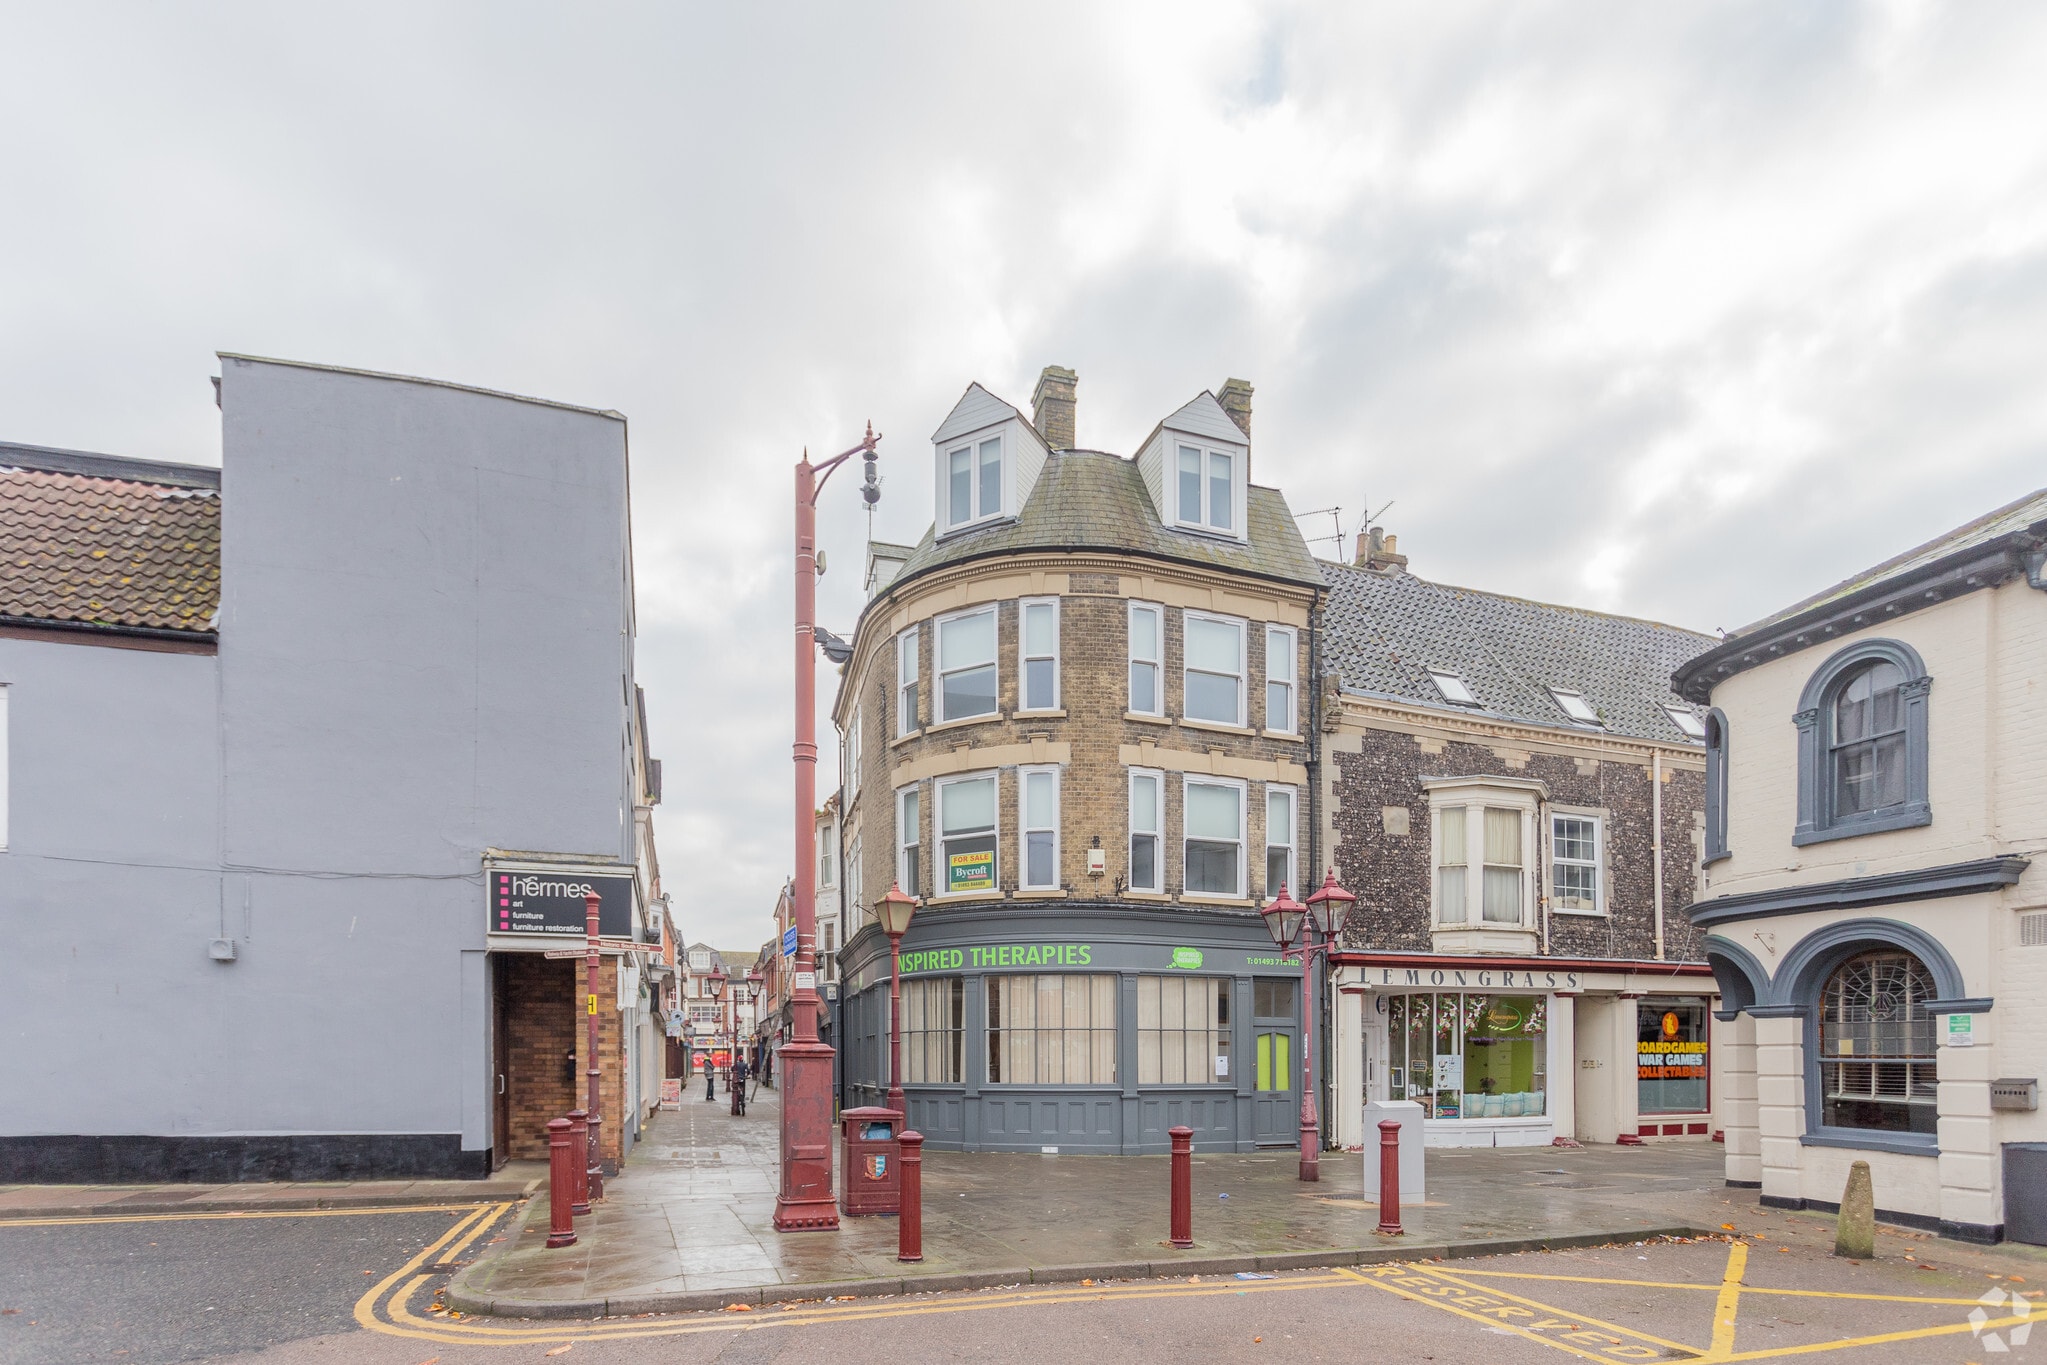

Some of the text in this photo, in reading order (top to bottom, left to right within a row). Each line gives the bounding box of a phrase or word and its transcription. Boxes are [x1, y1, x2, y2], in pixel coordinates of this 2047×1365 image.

[953, 854, 989, 863] FOR SALE
[955, 865, 987, 878] Bycroft
[513, 876, 592, 898] hermes
[512, 912, 544, 920] furniture
[512, 923, 584, 932] furniture restoration
[898, 945, 1092, 973] NSPIRED THERAPIES
[1360, 967, 1577, 988] LEMONGRASS
[1638, 1054, 1703, 1066] WAR GAMES
[1362, 1266, 1659, 1358] RESERVED
